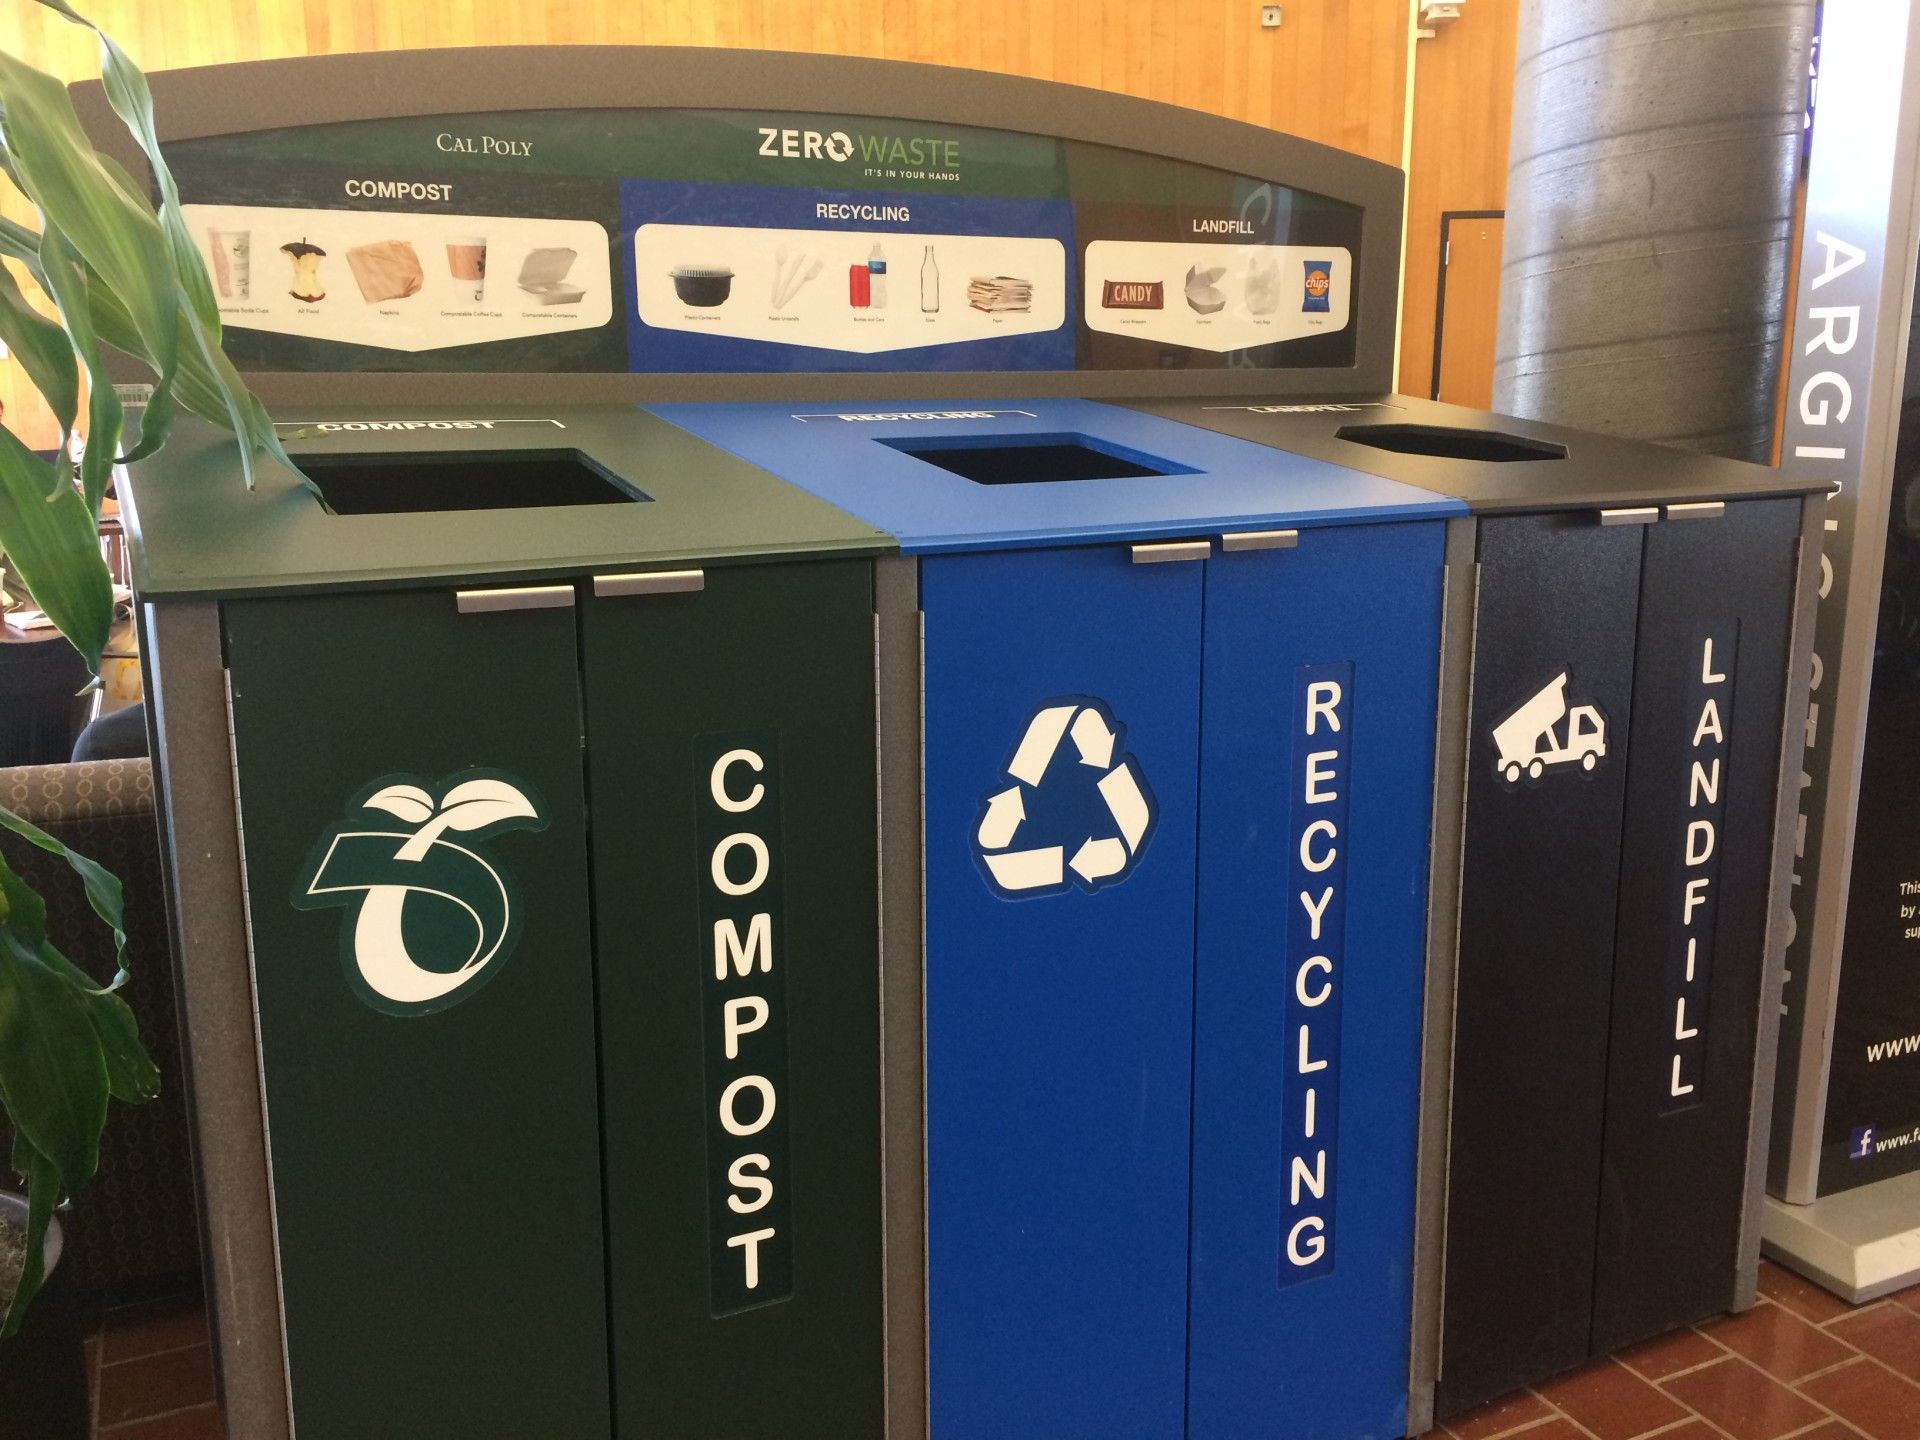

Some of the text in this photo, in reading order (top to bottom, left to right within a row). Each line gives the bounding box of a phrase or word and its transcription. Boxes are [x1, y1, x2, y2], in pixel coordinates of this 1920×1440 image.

[759, 127, 960, 168] ZERO WASTE
[864, 168, 960, 182] IT'S IN YOUR HANDS
[345, 179, 453, 201] COMPOST
[816, 203, 910, 222] RECYCLING
[1193, 219, 1255, 234] LANDFILL
[1305, 276, 1329, 291] chips
[1114, 285, 1152, 302] CANDY
[317, 421, 497, 431] COMPOST
[1670, 637, 1726, 1098] LANDFILL
[1900, 905, 1916, 919] by
[1287, 681, 1343, 1267] RECYCLING
[710, 749, 776, 1290] COMPOST
